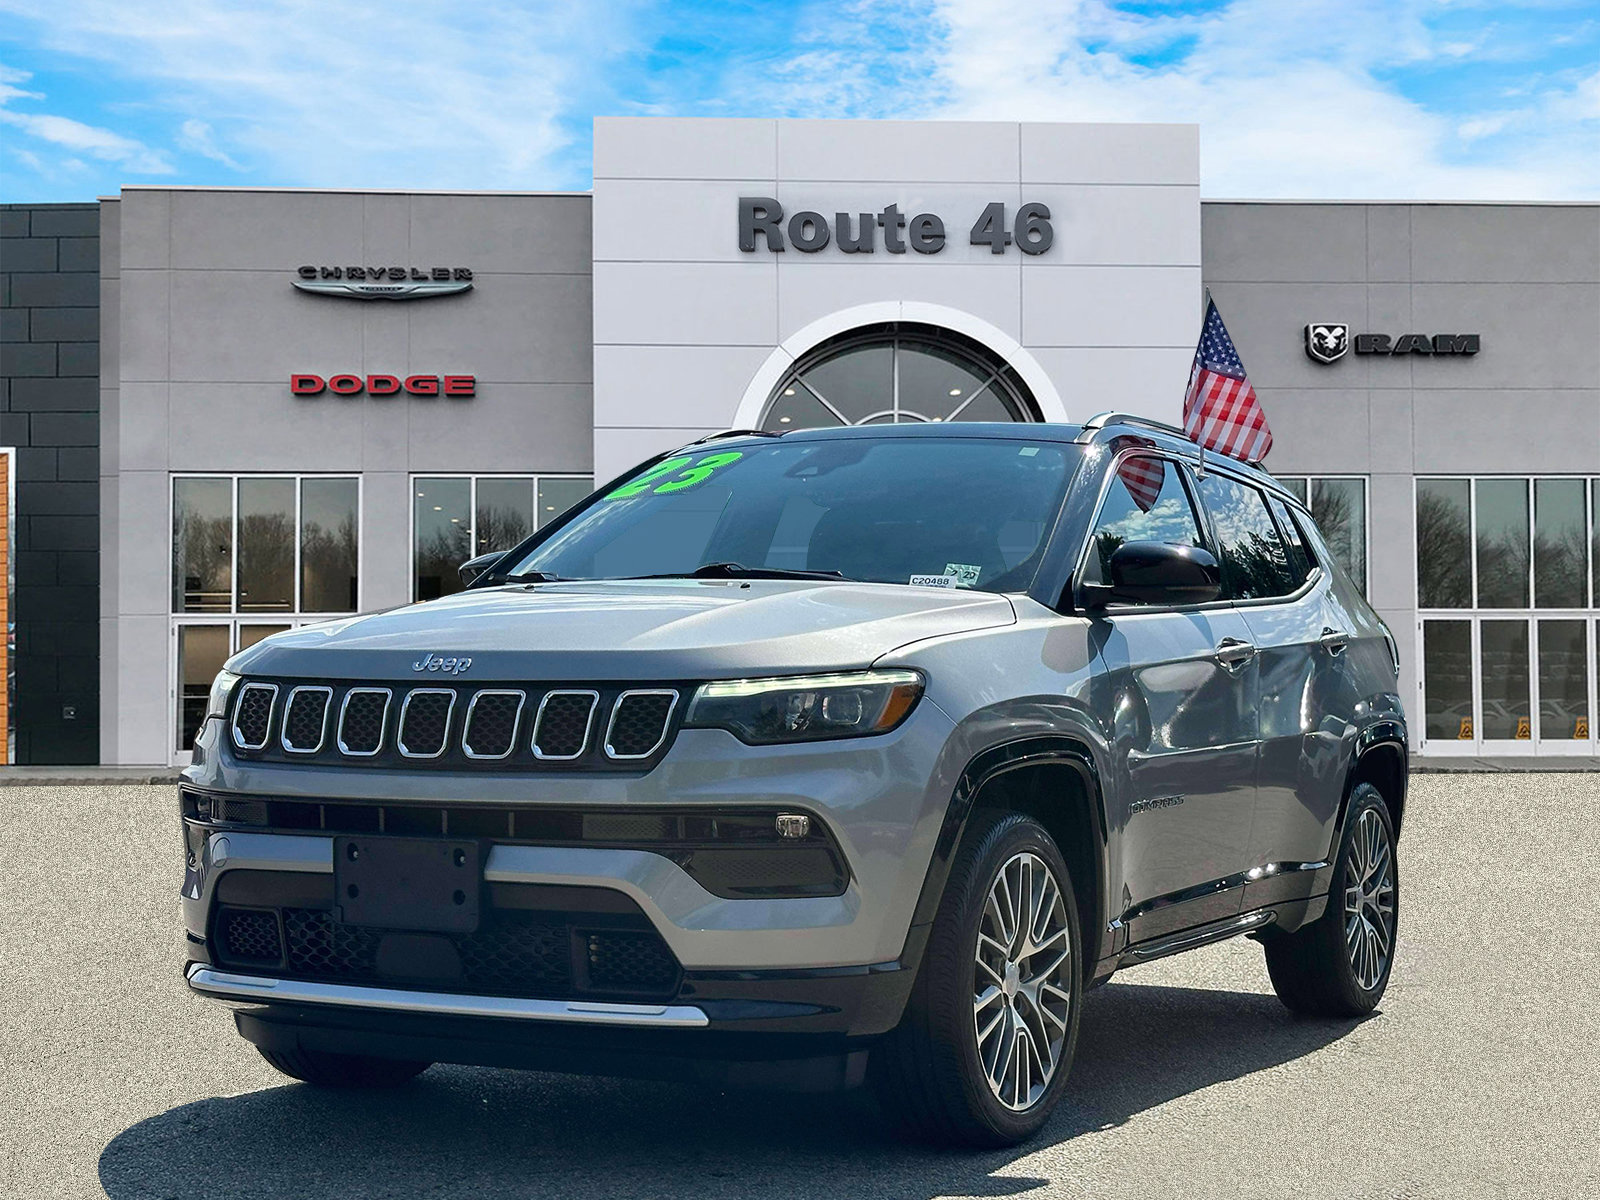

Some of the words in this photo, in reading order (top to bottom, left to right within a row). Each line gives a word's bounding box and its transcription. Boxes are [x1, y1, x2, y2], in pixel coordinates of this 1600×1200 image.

[738, 196, 947, 254] Route
[969, 201, 1054, 256] 46
[298, 265, 474, 281] CHRYSLER
[1354, 333, 1481, 357] RAM
[290, 373, 477, 398] DODGE
[603, 451, 743, 501] 23
[911, 577, 950, 586] C20488
[411, 653, 473, 676] Jeep
